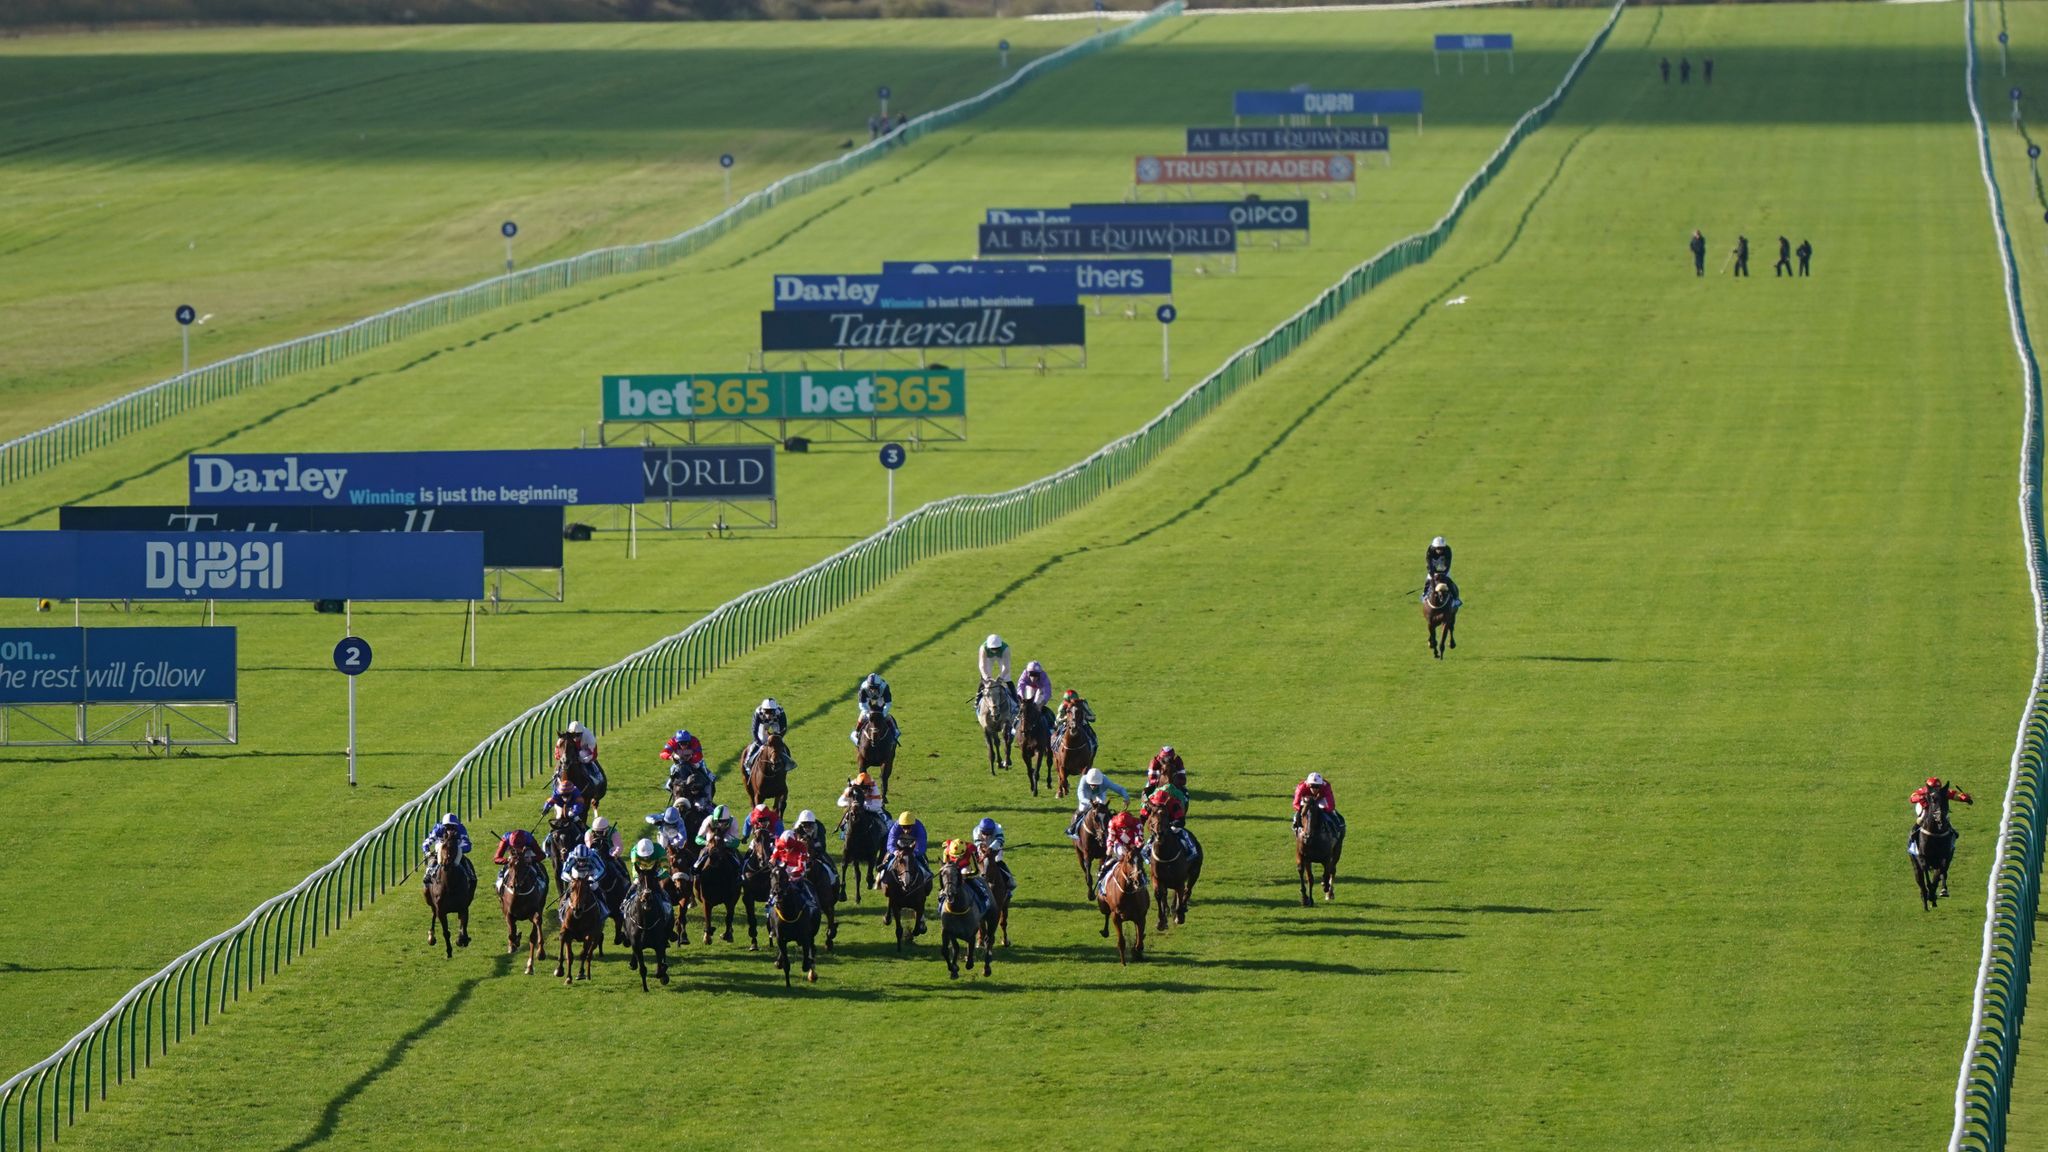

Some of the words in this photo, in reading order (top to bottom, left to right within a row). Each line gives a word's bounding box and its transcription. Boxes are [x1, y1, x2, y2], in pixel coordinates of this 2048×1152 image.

[1192, 132, 1212, 147] AL
[1219, 132, 1267, 147] BASTI
[1274, 130, 1385, 148] EQUIWORLD
[1164, 159, 1326, 178] TRUSTATRADER
[985, 231, 1013, 248] AL
[1021, 230, 1081, 247] BASTI
[1091, 228, 1231, 249] EQUIWORLD
[776, 276, 880, 305] Darley
[830, 309, 1017, 347] Tattersalls
[618, 379, 770, 416] bet365
[800, 376, 952, 413] bet365
[887, 449, 898, 463] 3
[194, 457, 348, 499] Darley
[349, 488, 416, 505] Winning
[420, 487, 434, 502] is
[437, 486, 467, 505] just
[471, 486, 496, 502] the
[500, 484, 578, 504] beginning
[146, 541, 283, 595] DUBAI
[345, 646, 360, 666] 2
[0, 662, 27, 689] he
[32, 665, 80, 688] rest
[86, 661, 126, 688] will
[130, 661, 206, 694] follow
